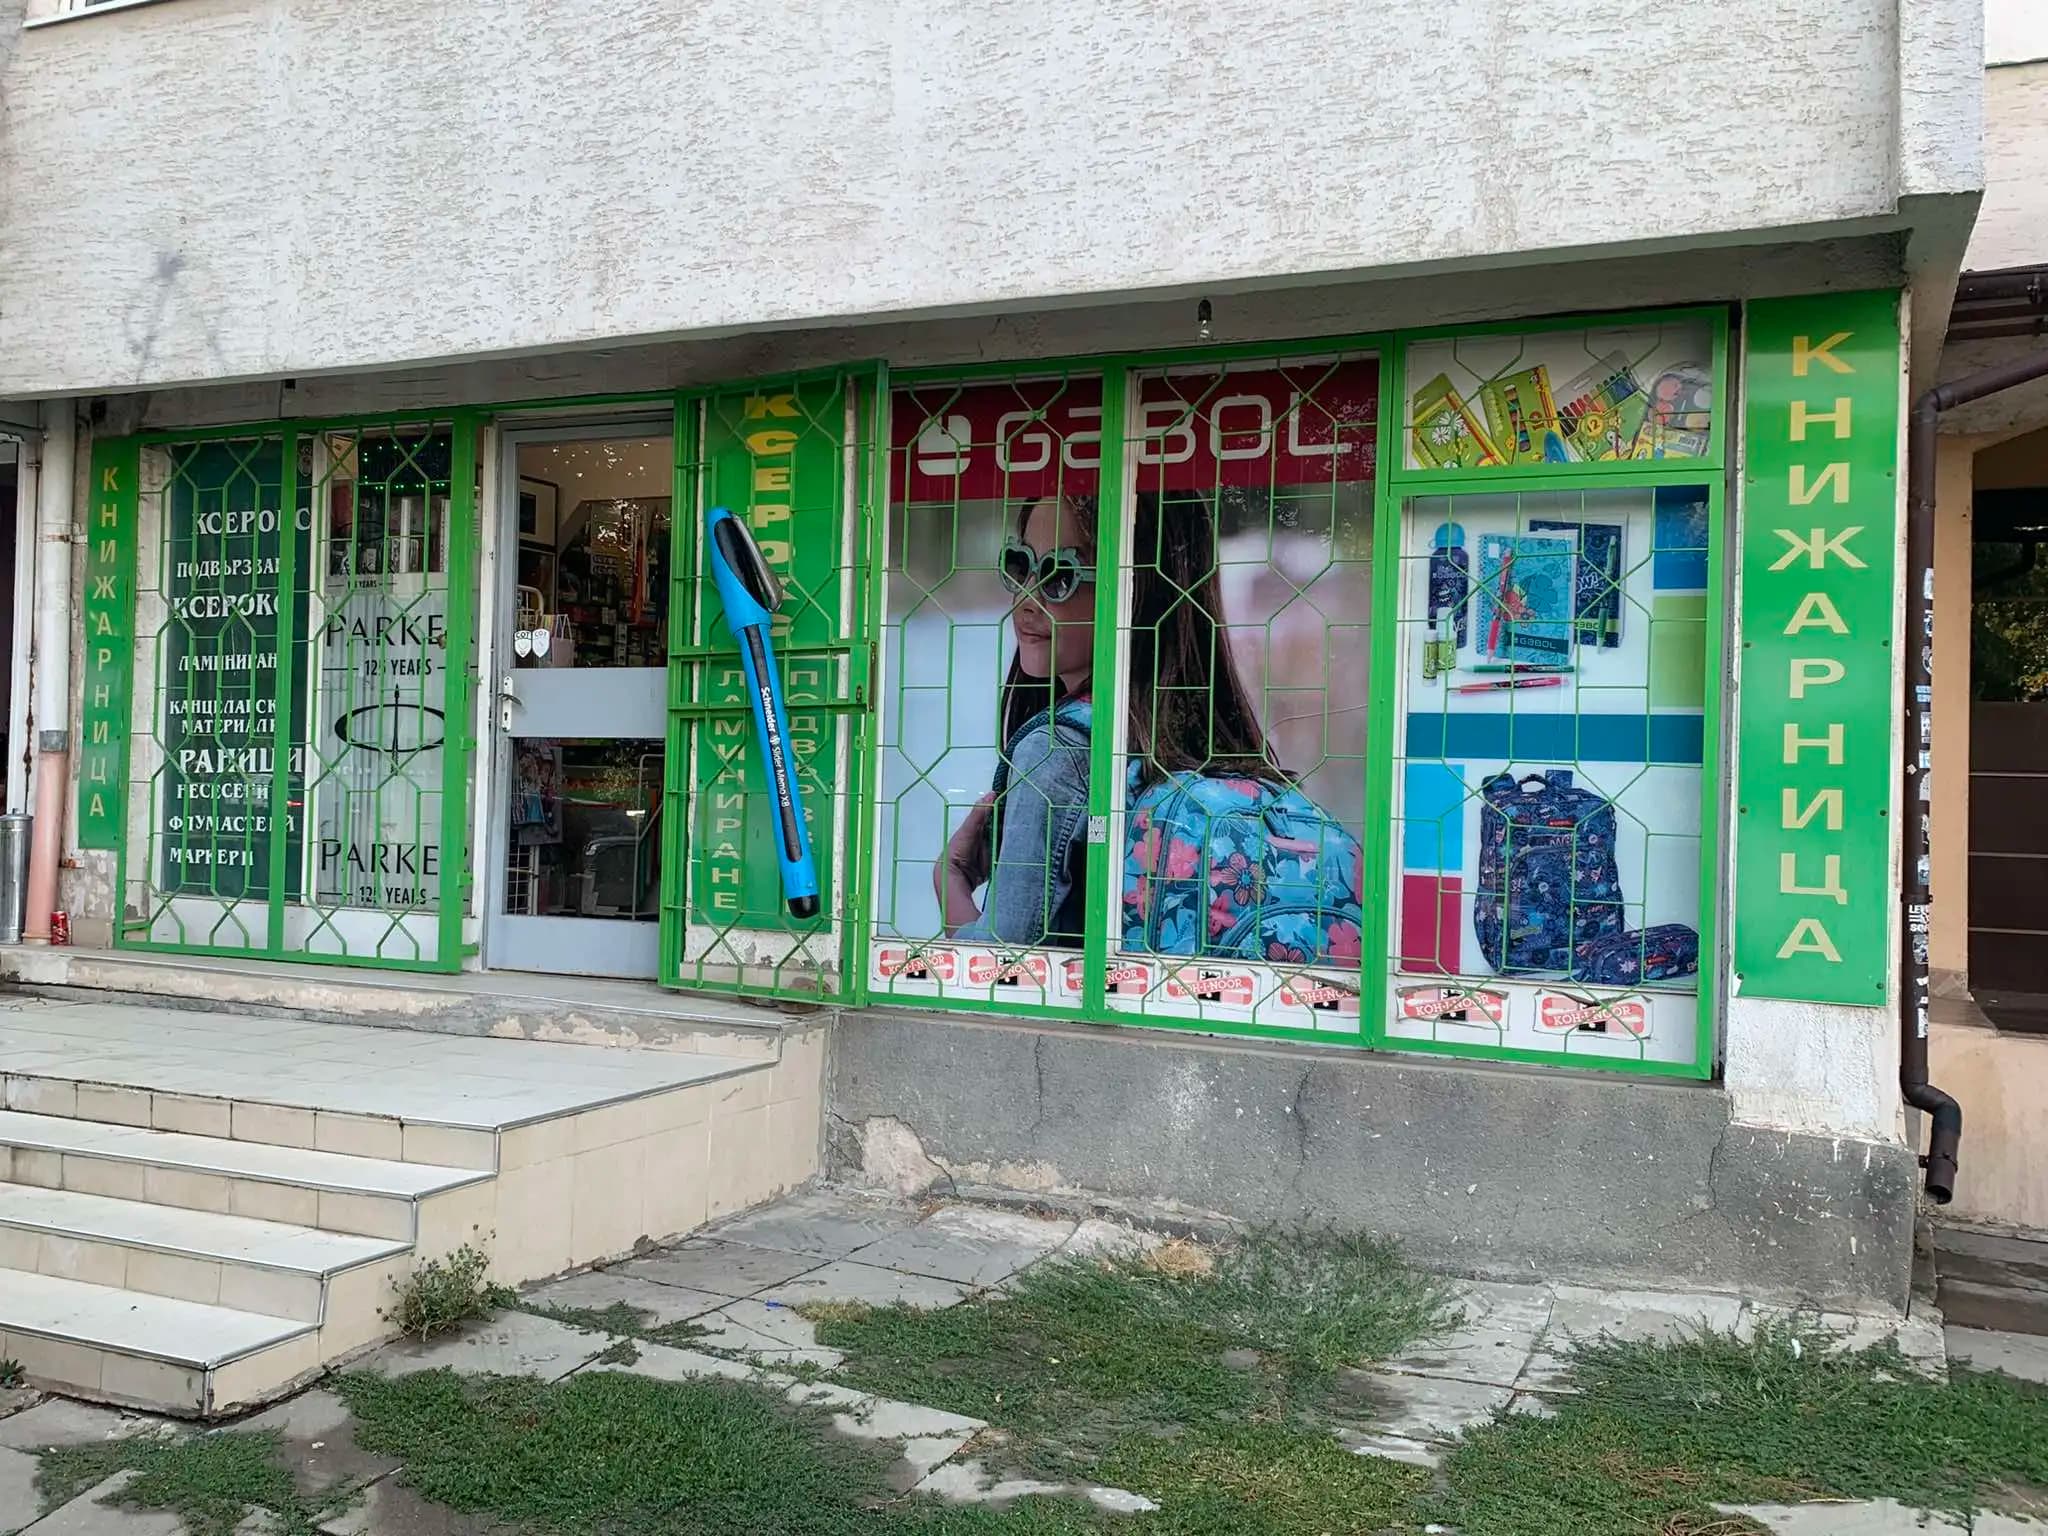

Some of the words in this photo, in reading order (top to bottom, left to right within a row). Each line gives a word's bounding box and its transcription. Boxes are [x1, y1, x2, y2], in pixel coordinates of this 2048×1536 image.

[995, 392, 1353, 472] GABOL
[192, 508, 312, 535] КСЕРОС
[173, 593, 282, 619] КСЕРОК
[88, 467, 117, 818] КНИЖАРНИЦА
[326, 614, 475, 647] PARKE
[1768, 331, 1869, 963] КНИЖАРНИЦА
[178, 652, 278, 671] ЛАМНИАН
[169, 699, 277, 718] КАНЦЛАСК
[761, 686, 777, 733] Schneider
[772, 746, 783, 768] Slider
[776, 769, 787, 795] Memo
[168, 815, 296, 833] ФЛУМАСЕИ
[321, 838, 472, 876] PARKE
